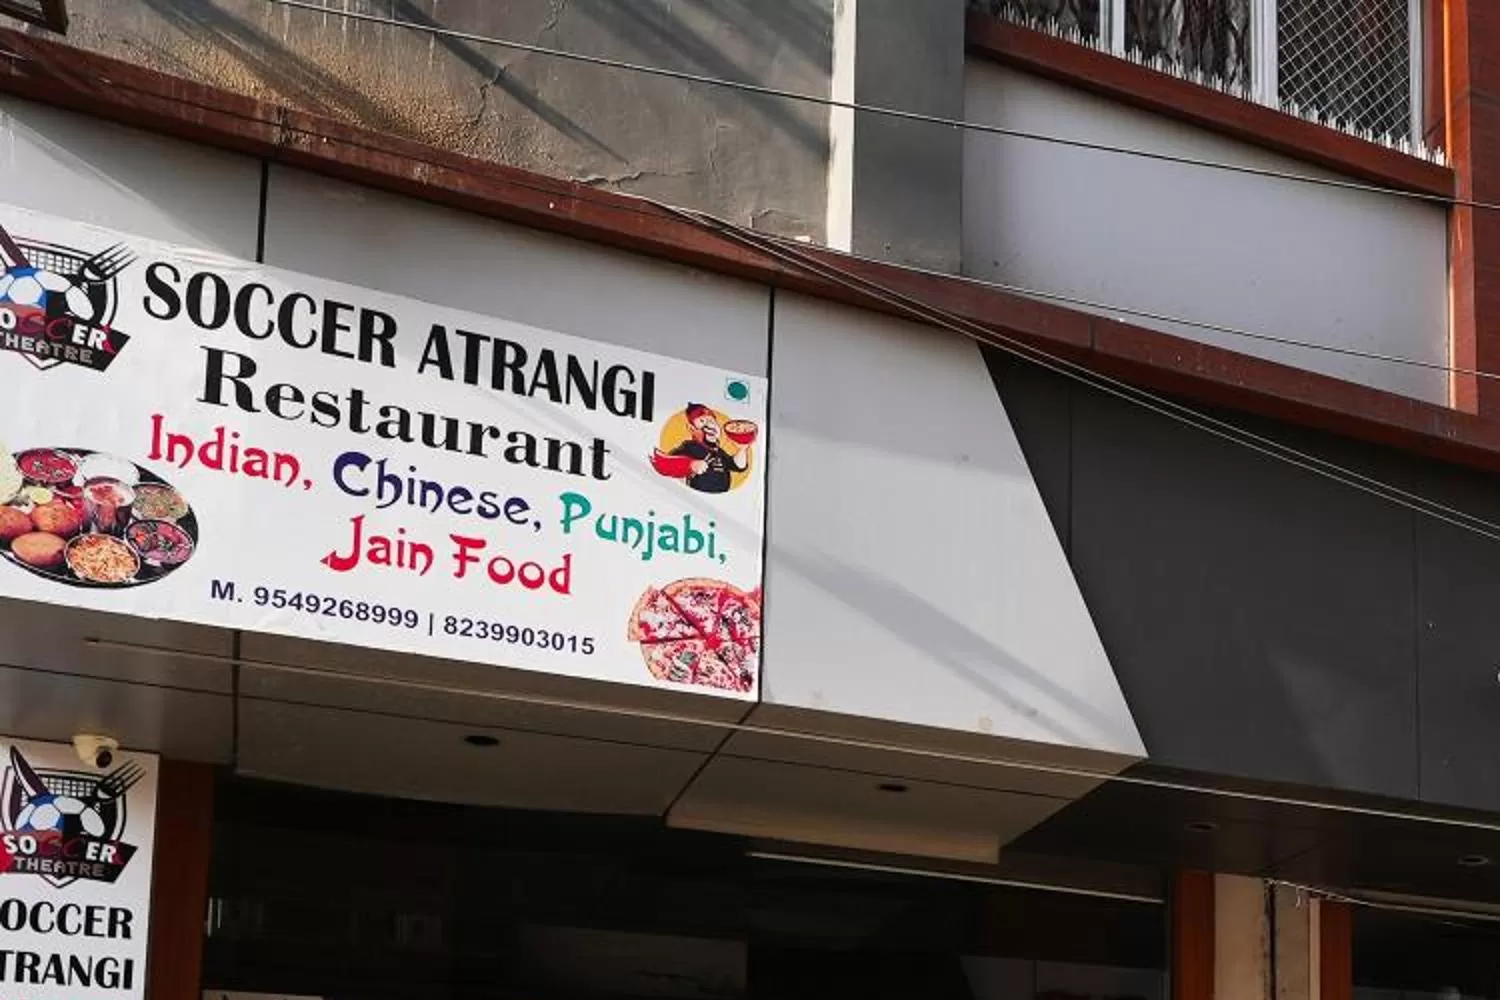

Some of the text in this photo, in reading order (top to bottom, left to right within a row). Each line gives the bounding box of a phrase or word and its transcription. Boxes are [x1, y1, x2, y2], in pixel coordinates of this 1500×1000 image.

[0, 307, 108, 351] OCCER
[0, 332, 93, 364] HEATRE
[143, 262, 655, 423] SOCCER ATRANGI
[197, 346, 613, 482] Restaurant
[146, 414, 728, 565] Indian, Chinese, Punjabi,
[320, 515, 573, 595] Jain Food
[210, 579, 242, 605] M.
[254, 586, 419, 630] 9549268999
[443, 615, 595, 657] 8239903015
[13, 855, 104, 877] THEATRE
[0, 898, 133, 939] OCCER
[0, 949, 133, 990] TRANGI
